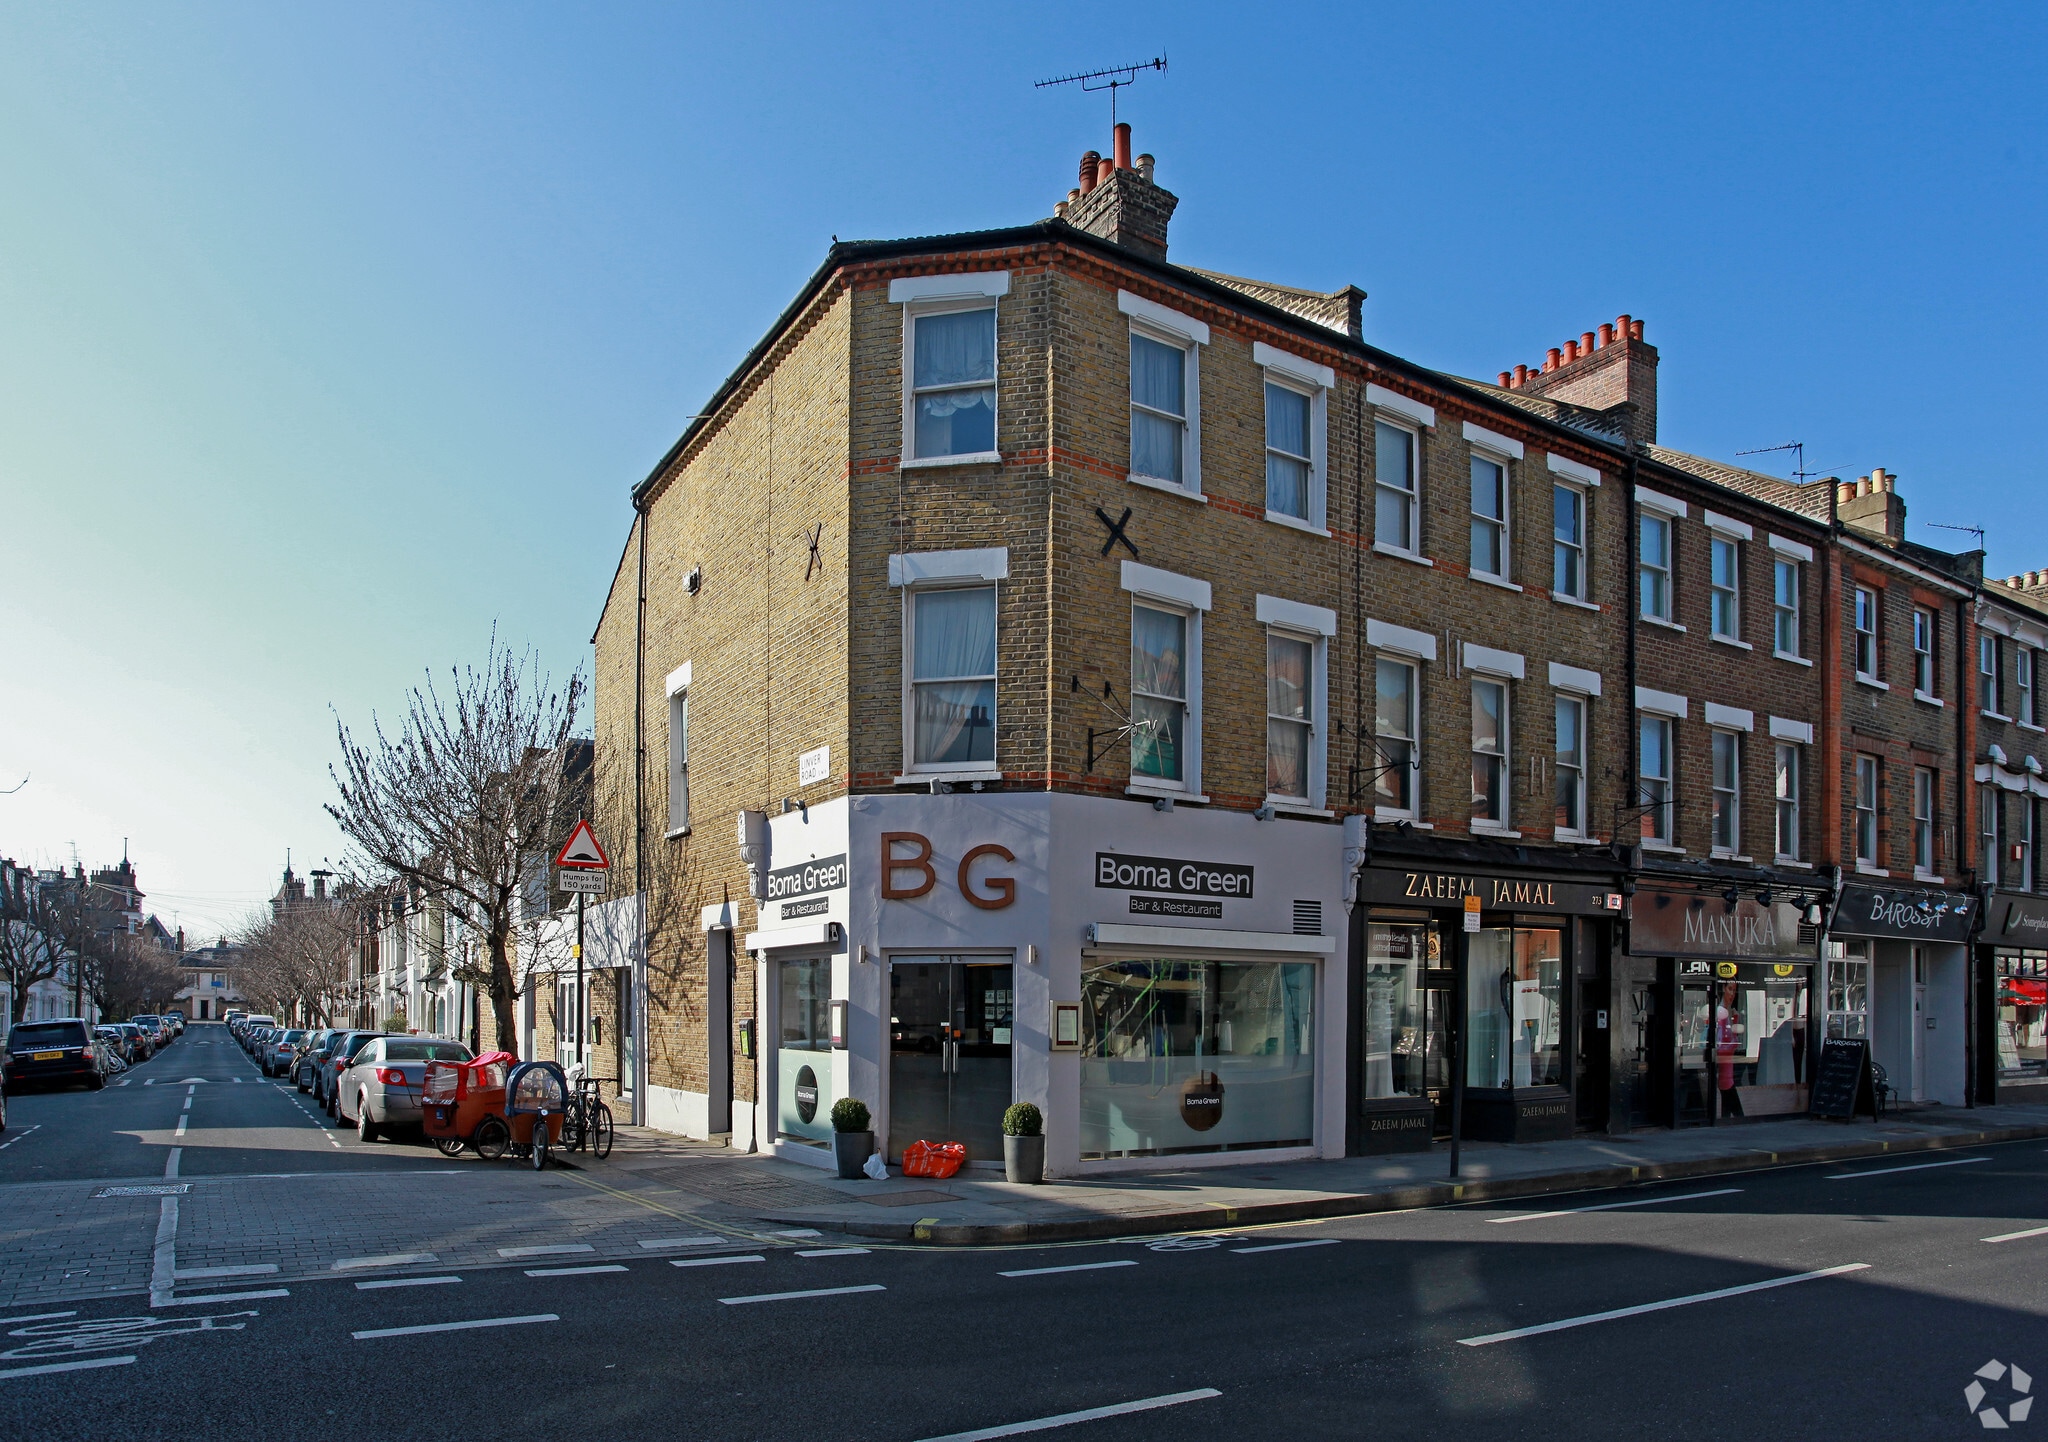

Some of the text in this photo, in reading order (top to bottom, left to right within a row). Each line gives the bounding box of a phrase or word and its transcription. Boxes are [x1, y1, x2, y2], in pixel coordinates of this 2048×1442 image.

[801, 767, 816, 781] ROAD
[562, 873, 590, 881] Humps
[768, 863, 845, 898] Boma Green
[1099, 857, 1250, 894] Boma Green
[580, 882, 602, 890] yards
[1405, 873, 1556, 908] ZAEEM JAMAL
[1591, 895, 1602, 905] 273
[781, 899, 829, 918] Bar & Restaurant
[1130, 900, 1221, 916] Bar & Restaurant
[1870, 894, 1944, 928] BAROSSA
[1683, 908, 1777, 947] MANUKA
[1825, 1038, 1862, 1047] BAROSSA
[1522, 1104, 1567, 1117] ZAEEM JAMAL
[1371, 1117, 1426, 1131] ZAEEM JAMAL
